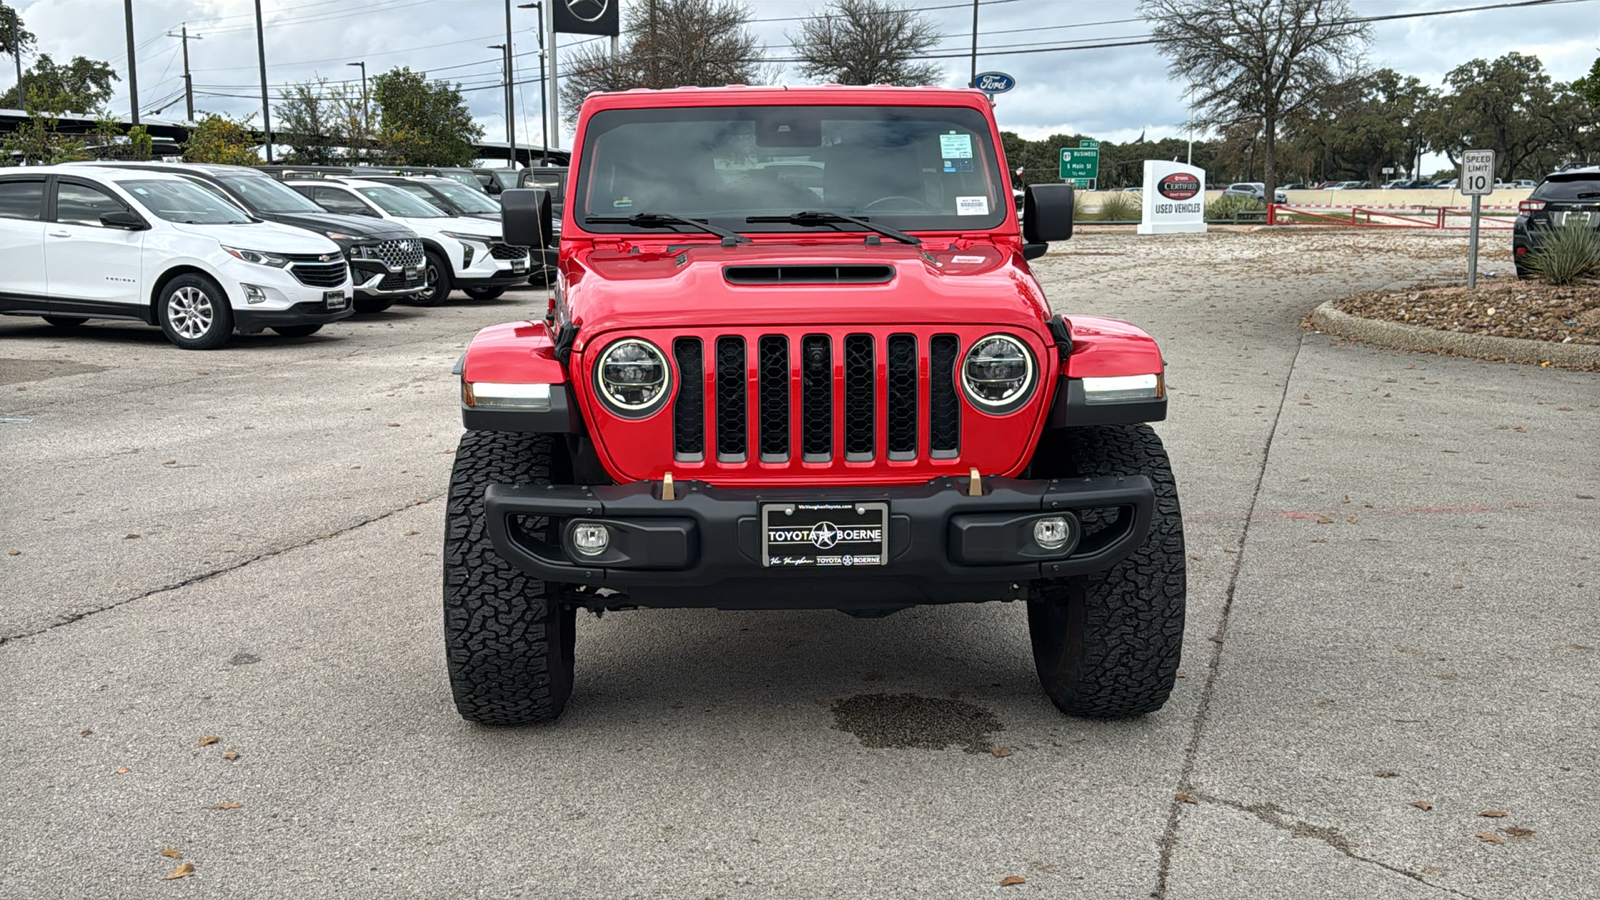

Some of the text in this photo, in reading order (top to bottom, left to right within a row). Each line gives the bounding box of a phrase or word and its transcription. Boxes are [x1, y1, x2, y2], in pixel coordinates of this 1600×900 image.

[980, 75, 1007, 89] Ford
[1466, 155, 1491, 163] SPEED
[1469, 175, 1486, 190] 10
[1155, 203, 1201, 214] USED VEHICLES
[768, 531, 817, 541] TOYOTA
[837, 530, 882, 539] BOERNE
